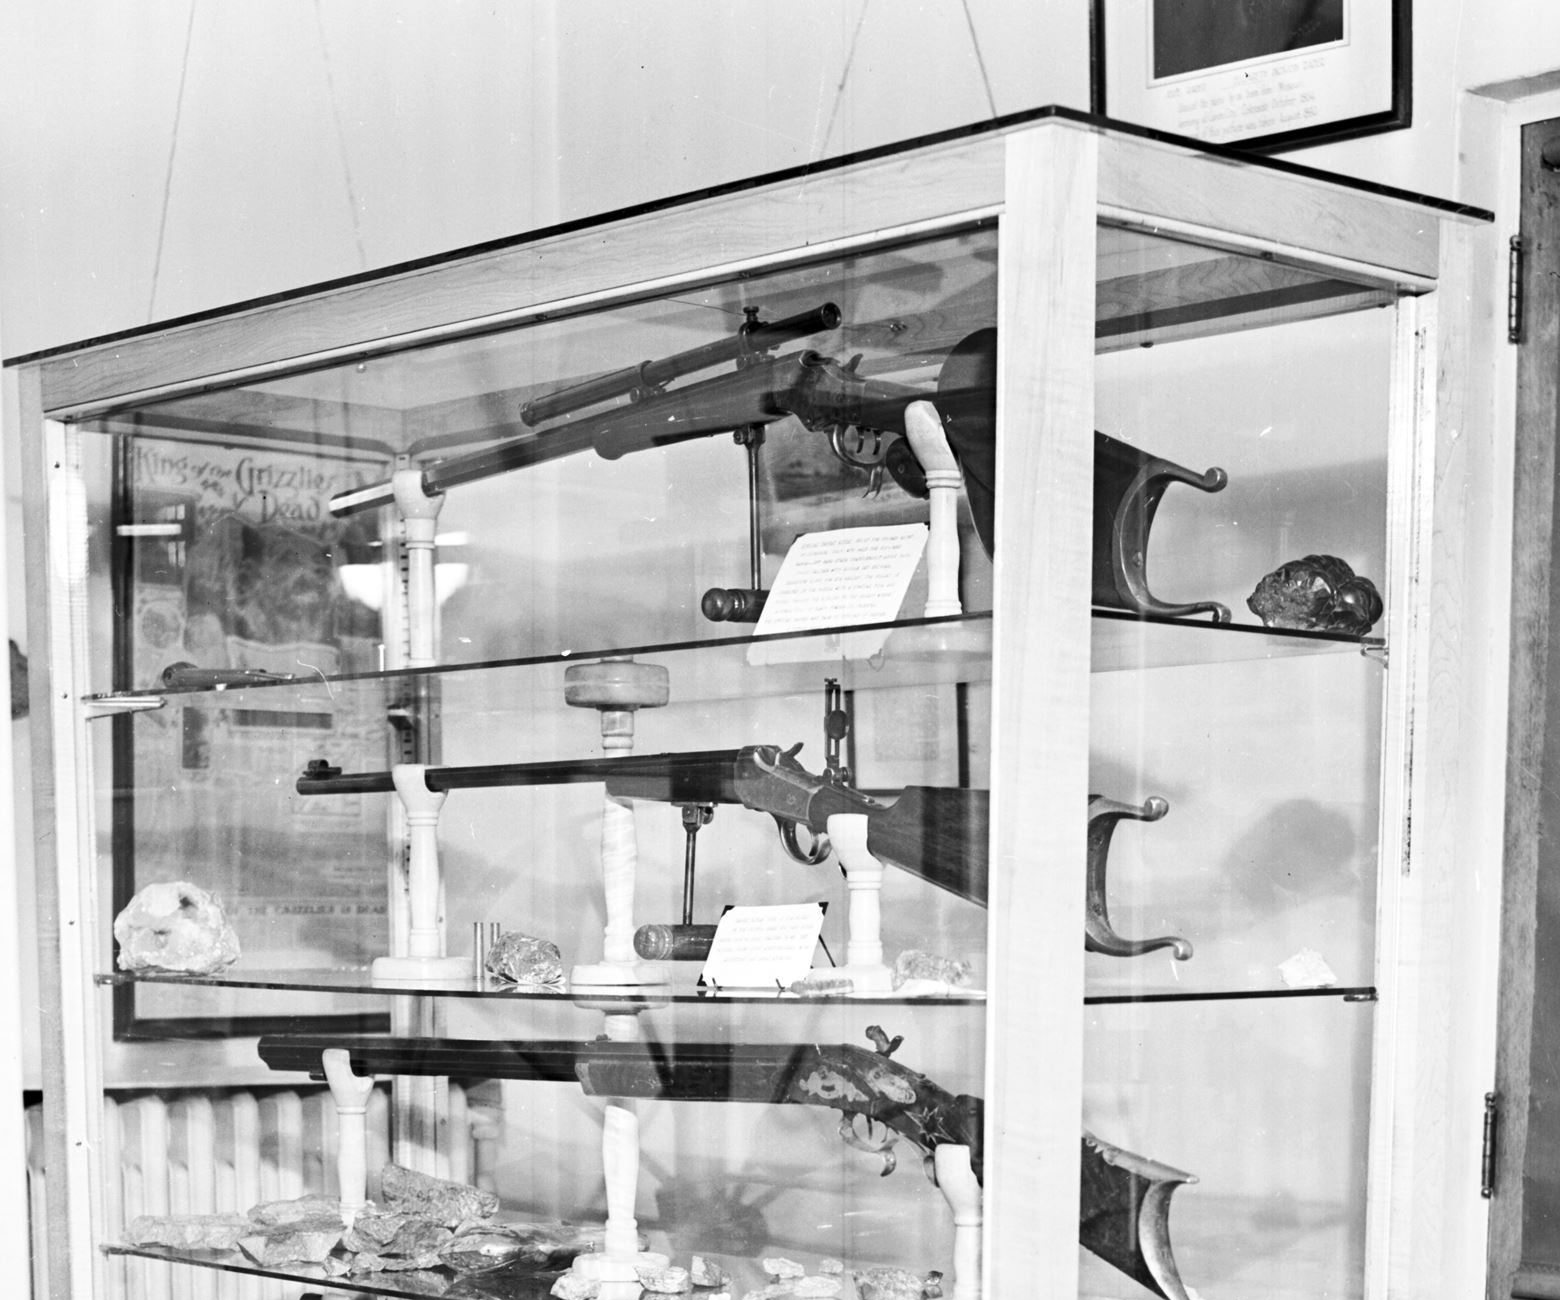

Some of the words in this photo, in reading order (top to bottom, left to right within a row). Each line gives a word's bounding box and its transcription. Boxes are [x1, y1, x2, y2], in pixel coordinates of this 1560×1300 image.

[135, 447, 188, 484] King
[236, 456, 338, 496] Grizzlies
[246, 487, 321, 524] Dead
